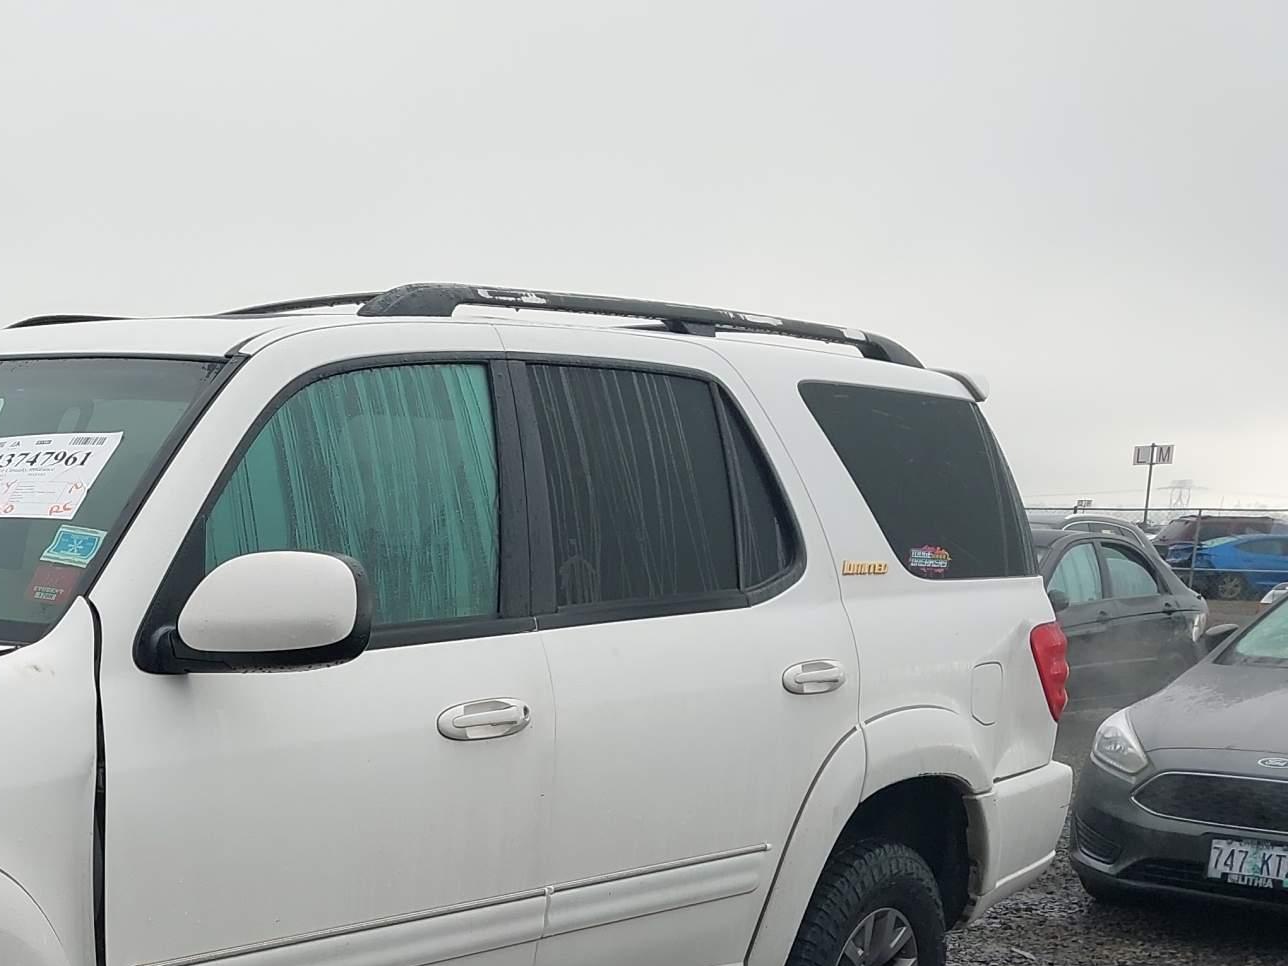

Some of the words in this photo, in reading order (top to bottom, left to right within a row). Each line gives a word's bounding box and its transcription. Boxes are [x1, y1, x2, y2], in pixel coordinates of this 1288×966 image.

[1136, 447, 1146, 463] L
[1158, 446, 1171, 462] M
[1213, 846, 1249, 873] 747
[1260, 852, 1288, 879] KT
